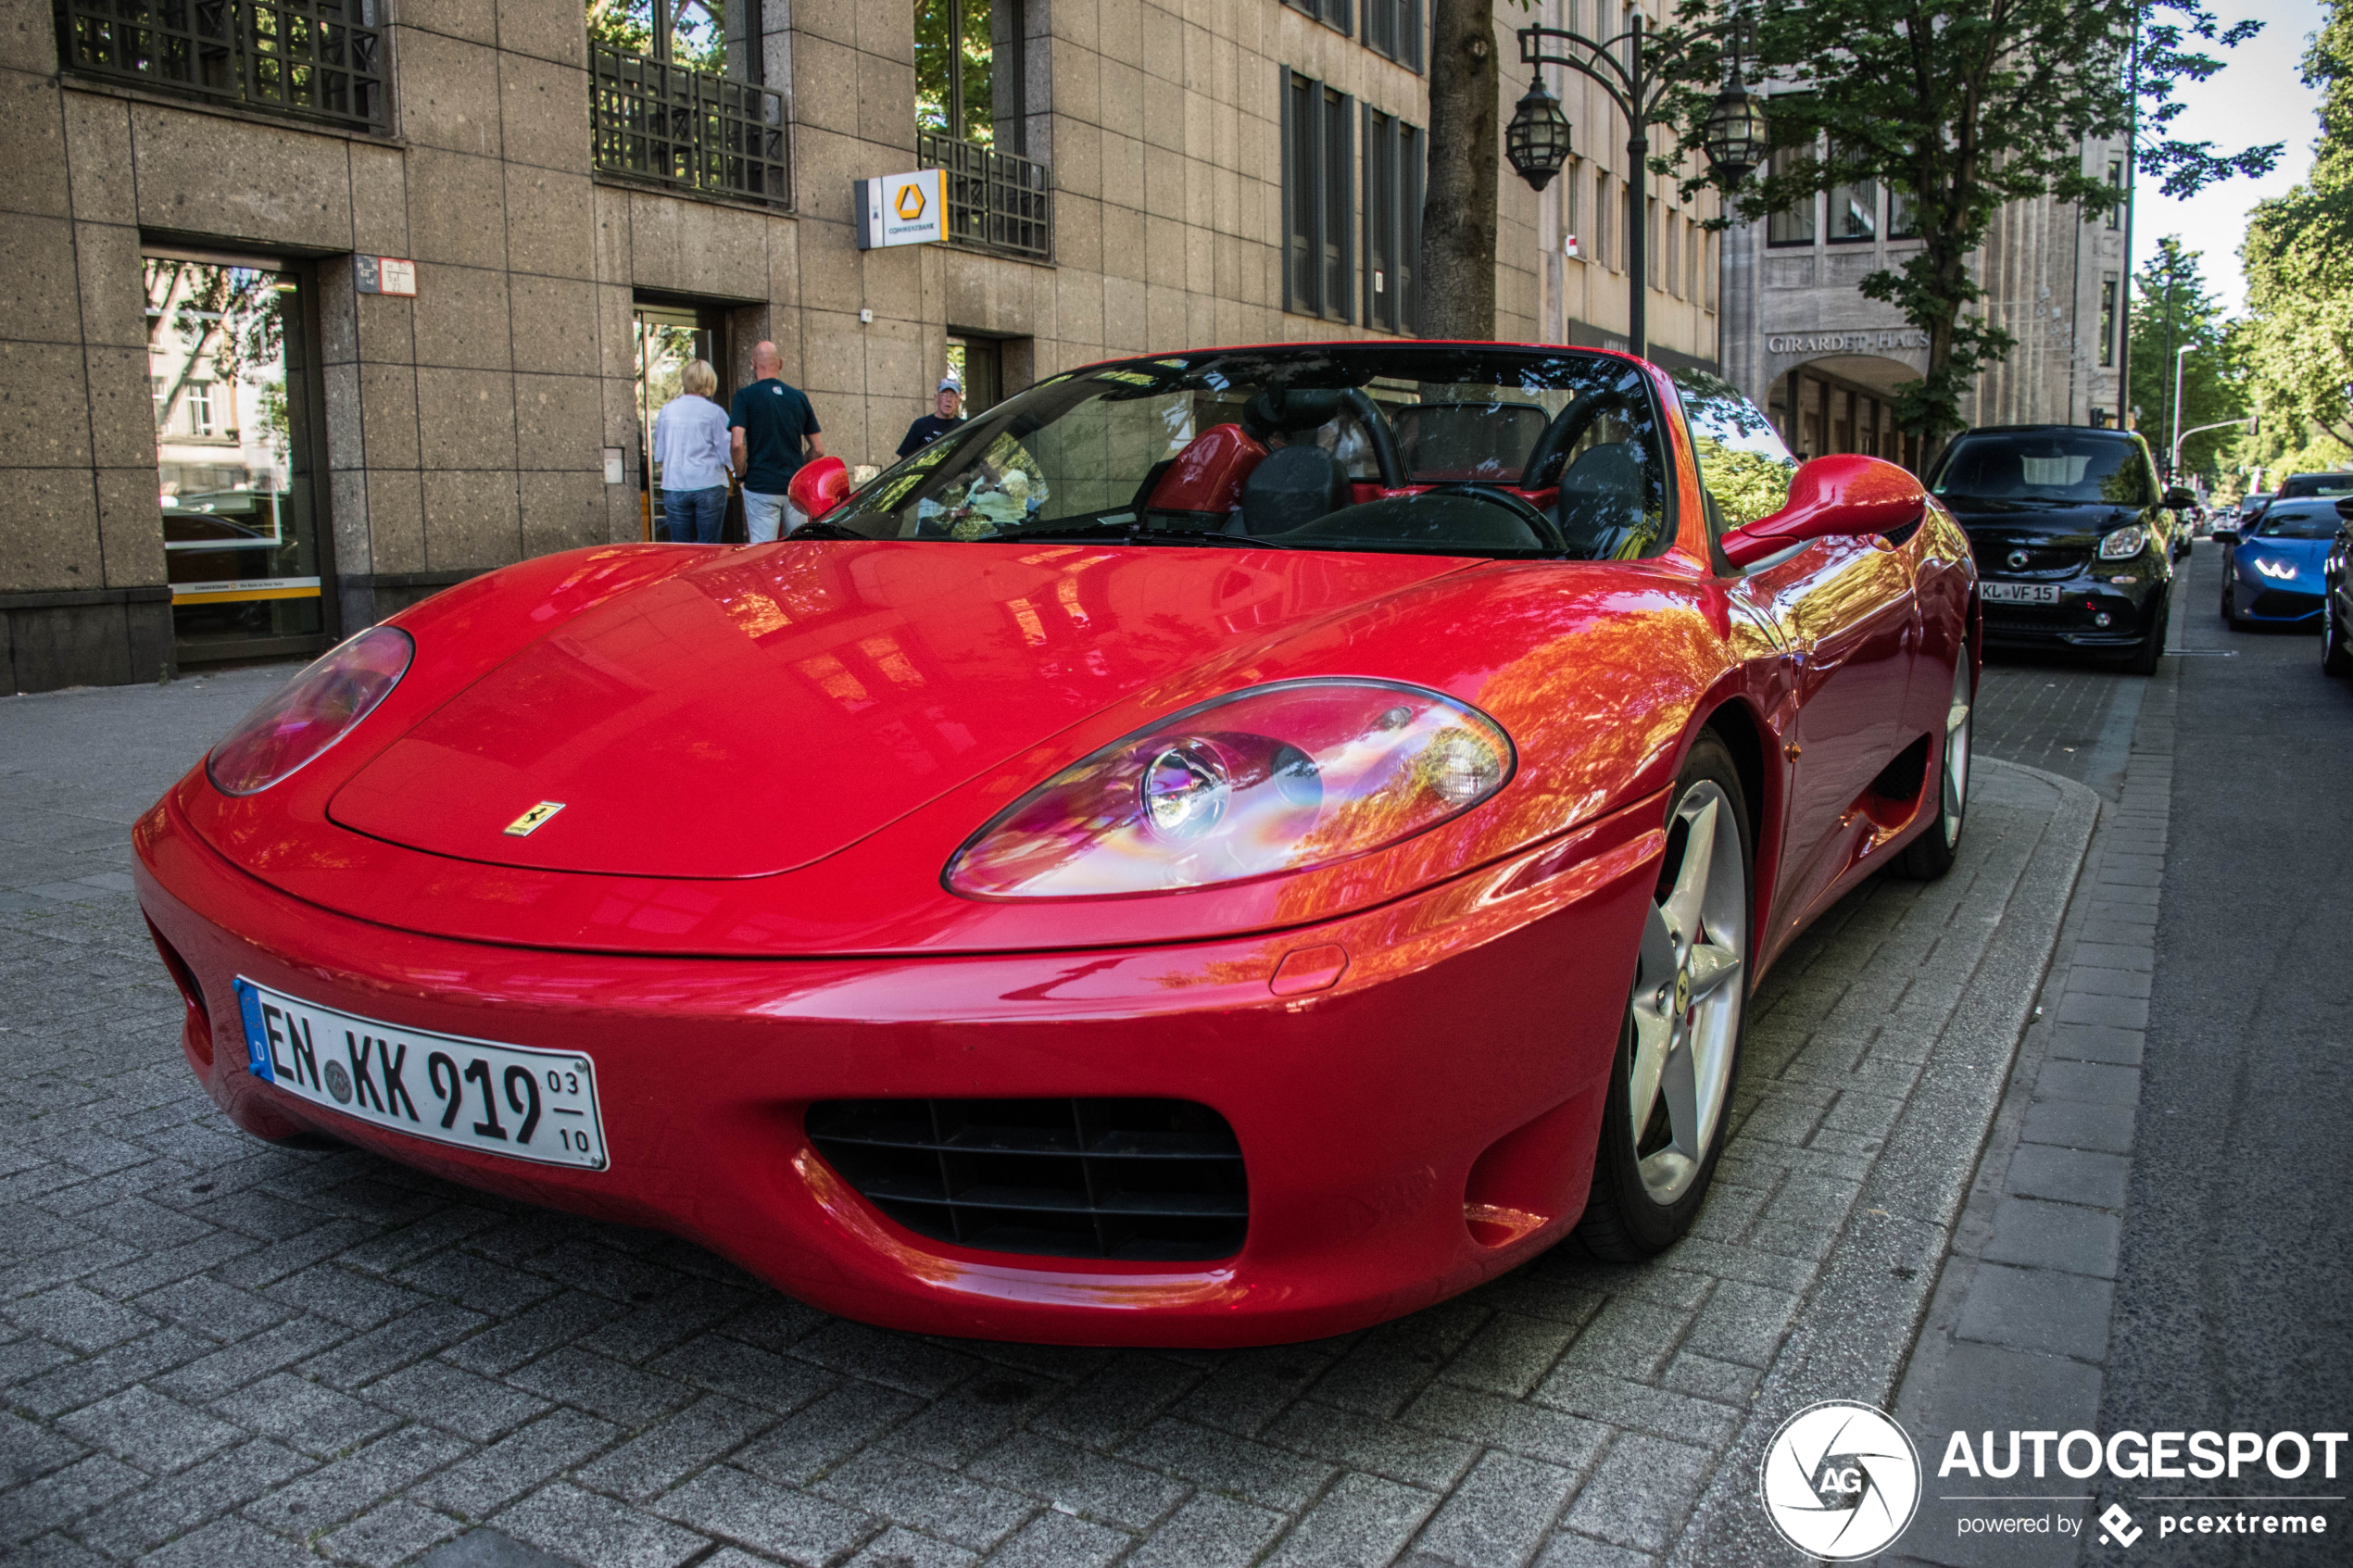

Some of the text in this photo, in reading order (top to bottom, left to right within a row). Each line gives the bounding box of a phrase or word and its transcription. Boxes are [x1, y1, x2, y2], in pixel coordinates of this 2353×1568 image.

[888, 222, 935, 234] COMMERZBANK
[1982, 584, 2053, 601] KL VF 15
[255, 1041, 265, 1060] D
[262, 1003, 542, 1144] EN KK 919
[547, 1070, 579, 1095] 03
[560, 1128, 589, 1152] 10
